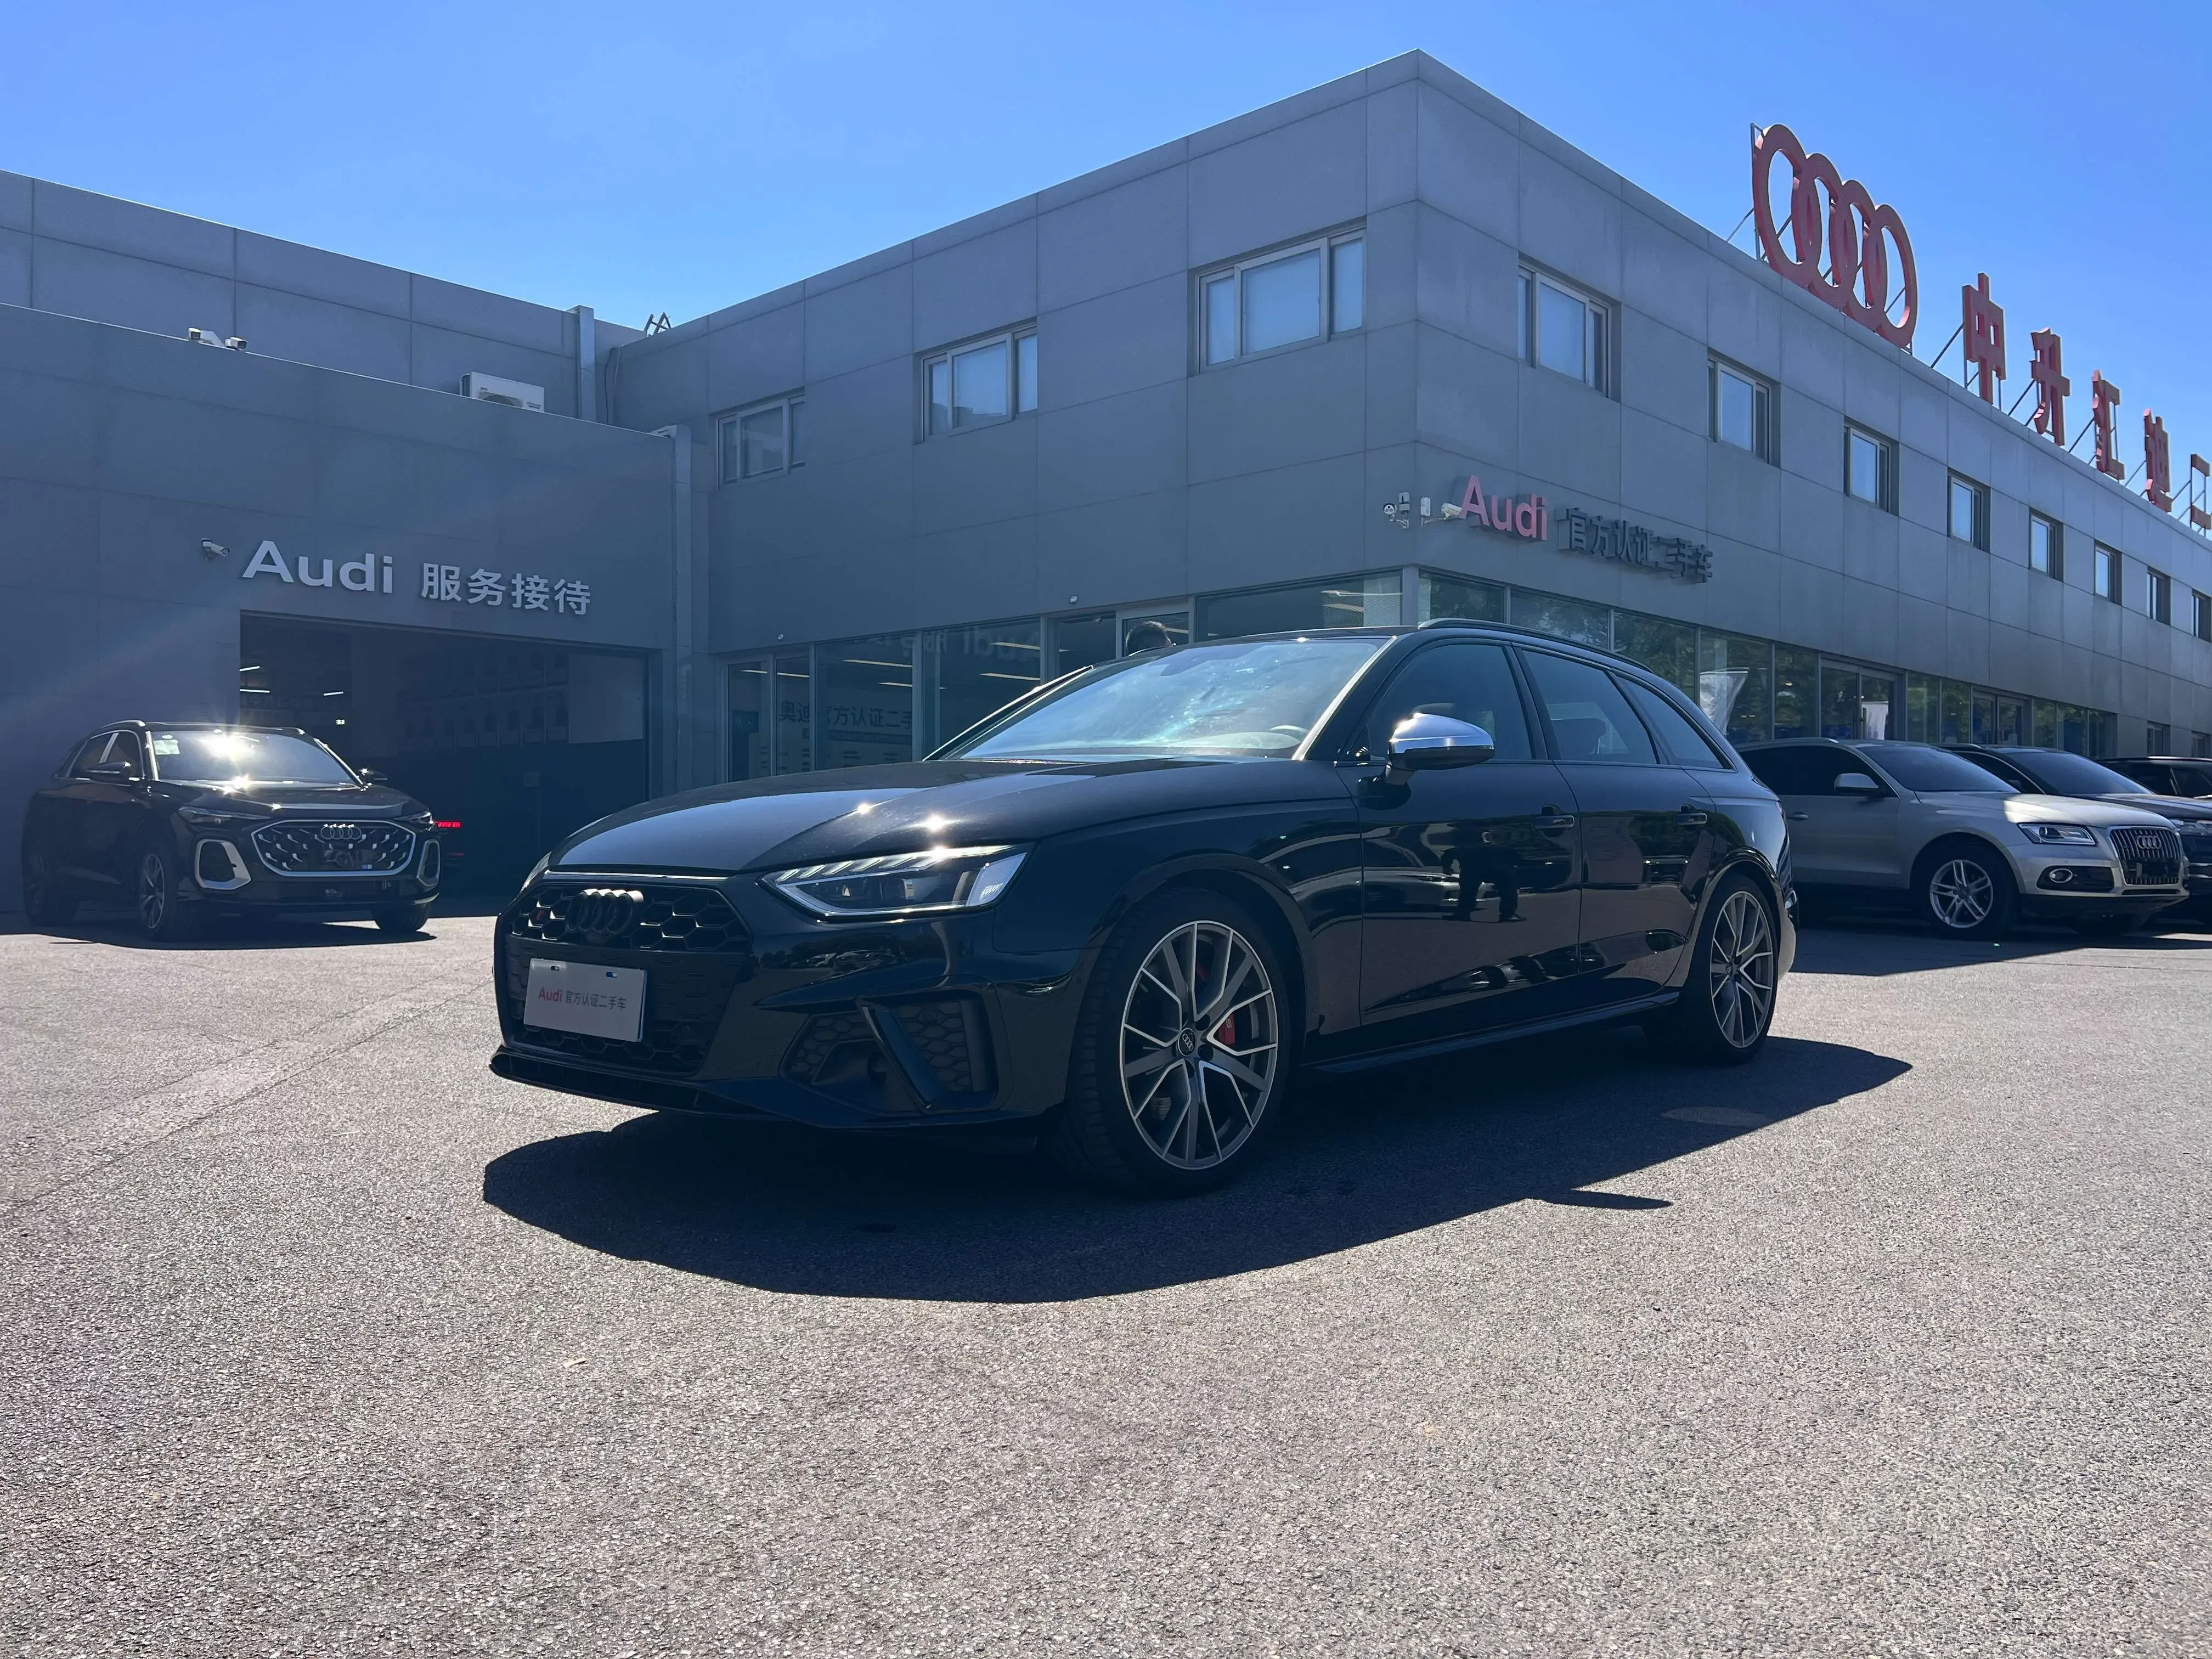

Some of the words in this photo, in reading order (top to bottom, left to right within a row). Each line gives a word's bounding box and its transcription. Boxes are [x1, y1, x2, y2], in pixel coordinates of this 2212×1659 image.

[1458, 475, 1548, 541] Audi
[1555, 507, 1713, 583] 官方认证二手车
[242, 540, 393, 594] Audi
[421, 562, 591, 616] 服务接待
[538, 986, 563, 1002] Audi
[566, 990, 627, 1011] 官方认证二手车
